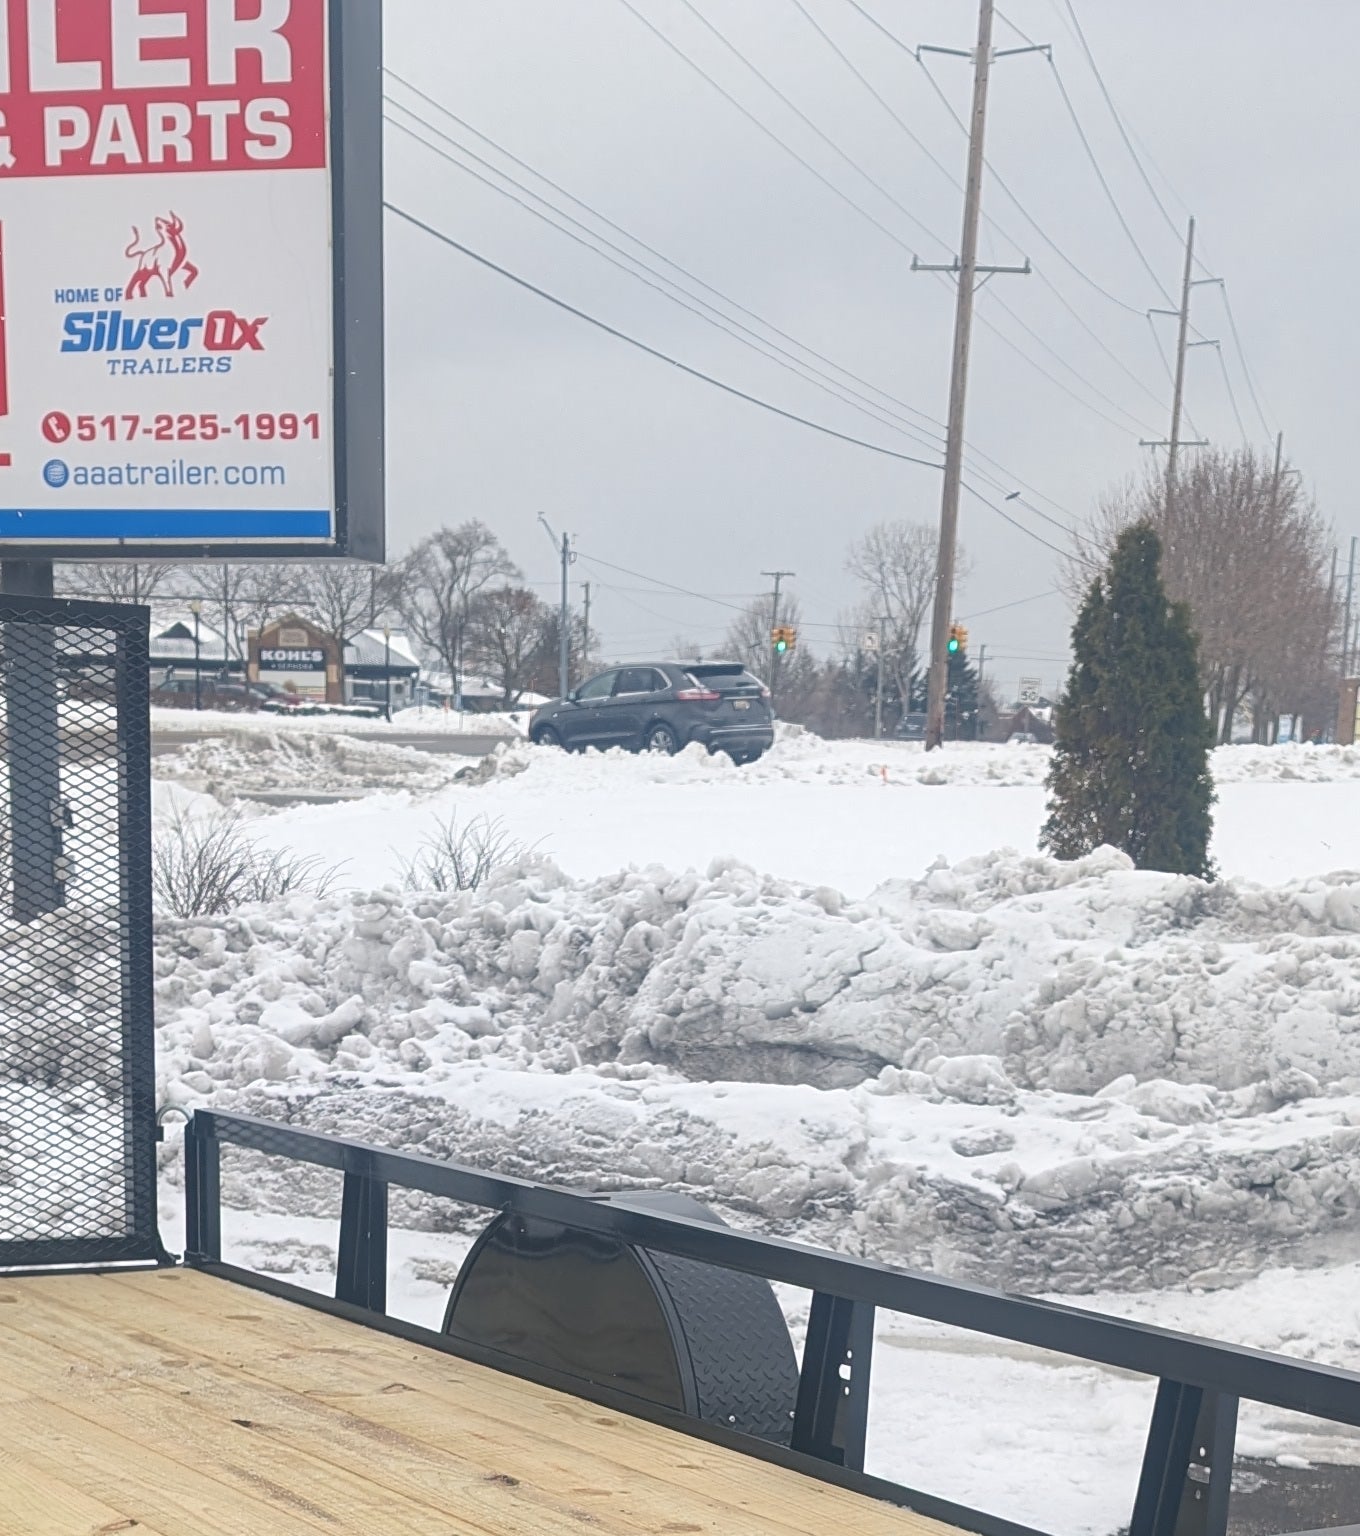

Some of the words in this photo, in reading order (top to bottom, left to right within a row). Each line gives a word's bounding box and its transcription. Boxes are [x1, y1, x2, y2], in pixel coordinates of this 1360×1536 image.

[44, 97, 293, 167] PARTS
[54, 288, 99, 303] HOME
[104, 287, 123, 302] OF
[107, 356, 233, 375] TRAILERS
[76, 412, 321, 442] 517-225-1991
[73, 459, 286, 486] aaatrailer.com
[260, 649, 324, 662] KOHL'S
